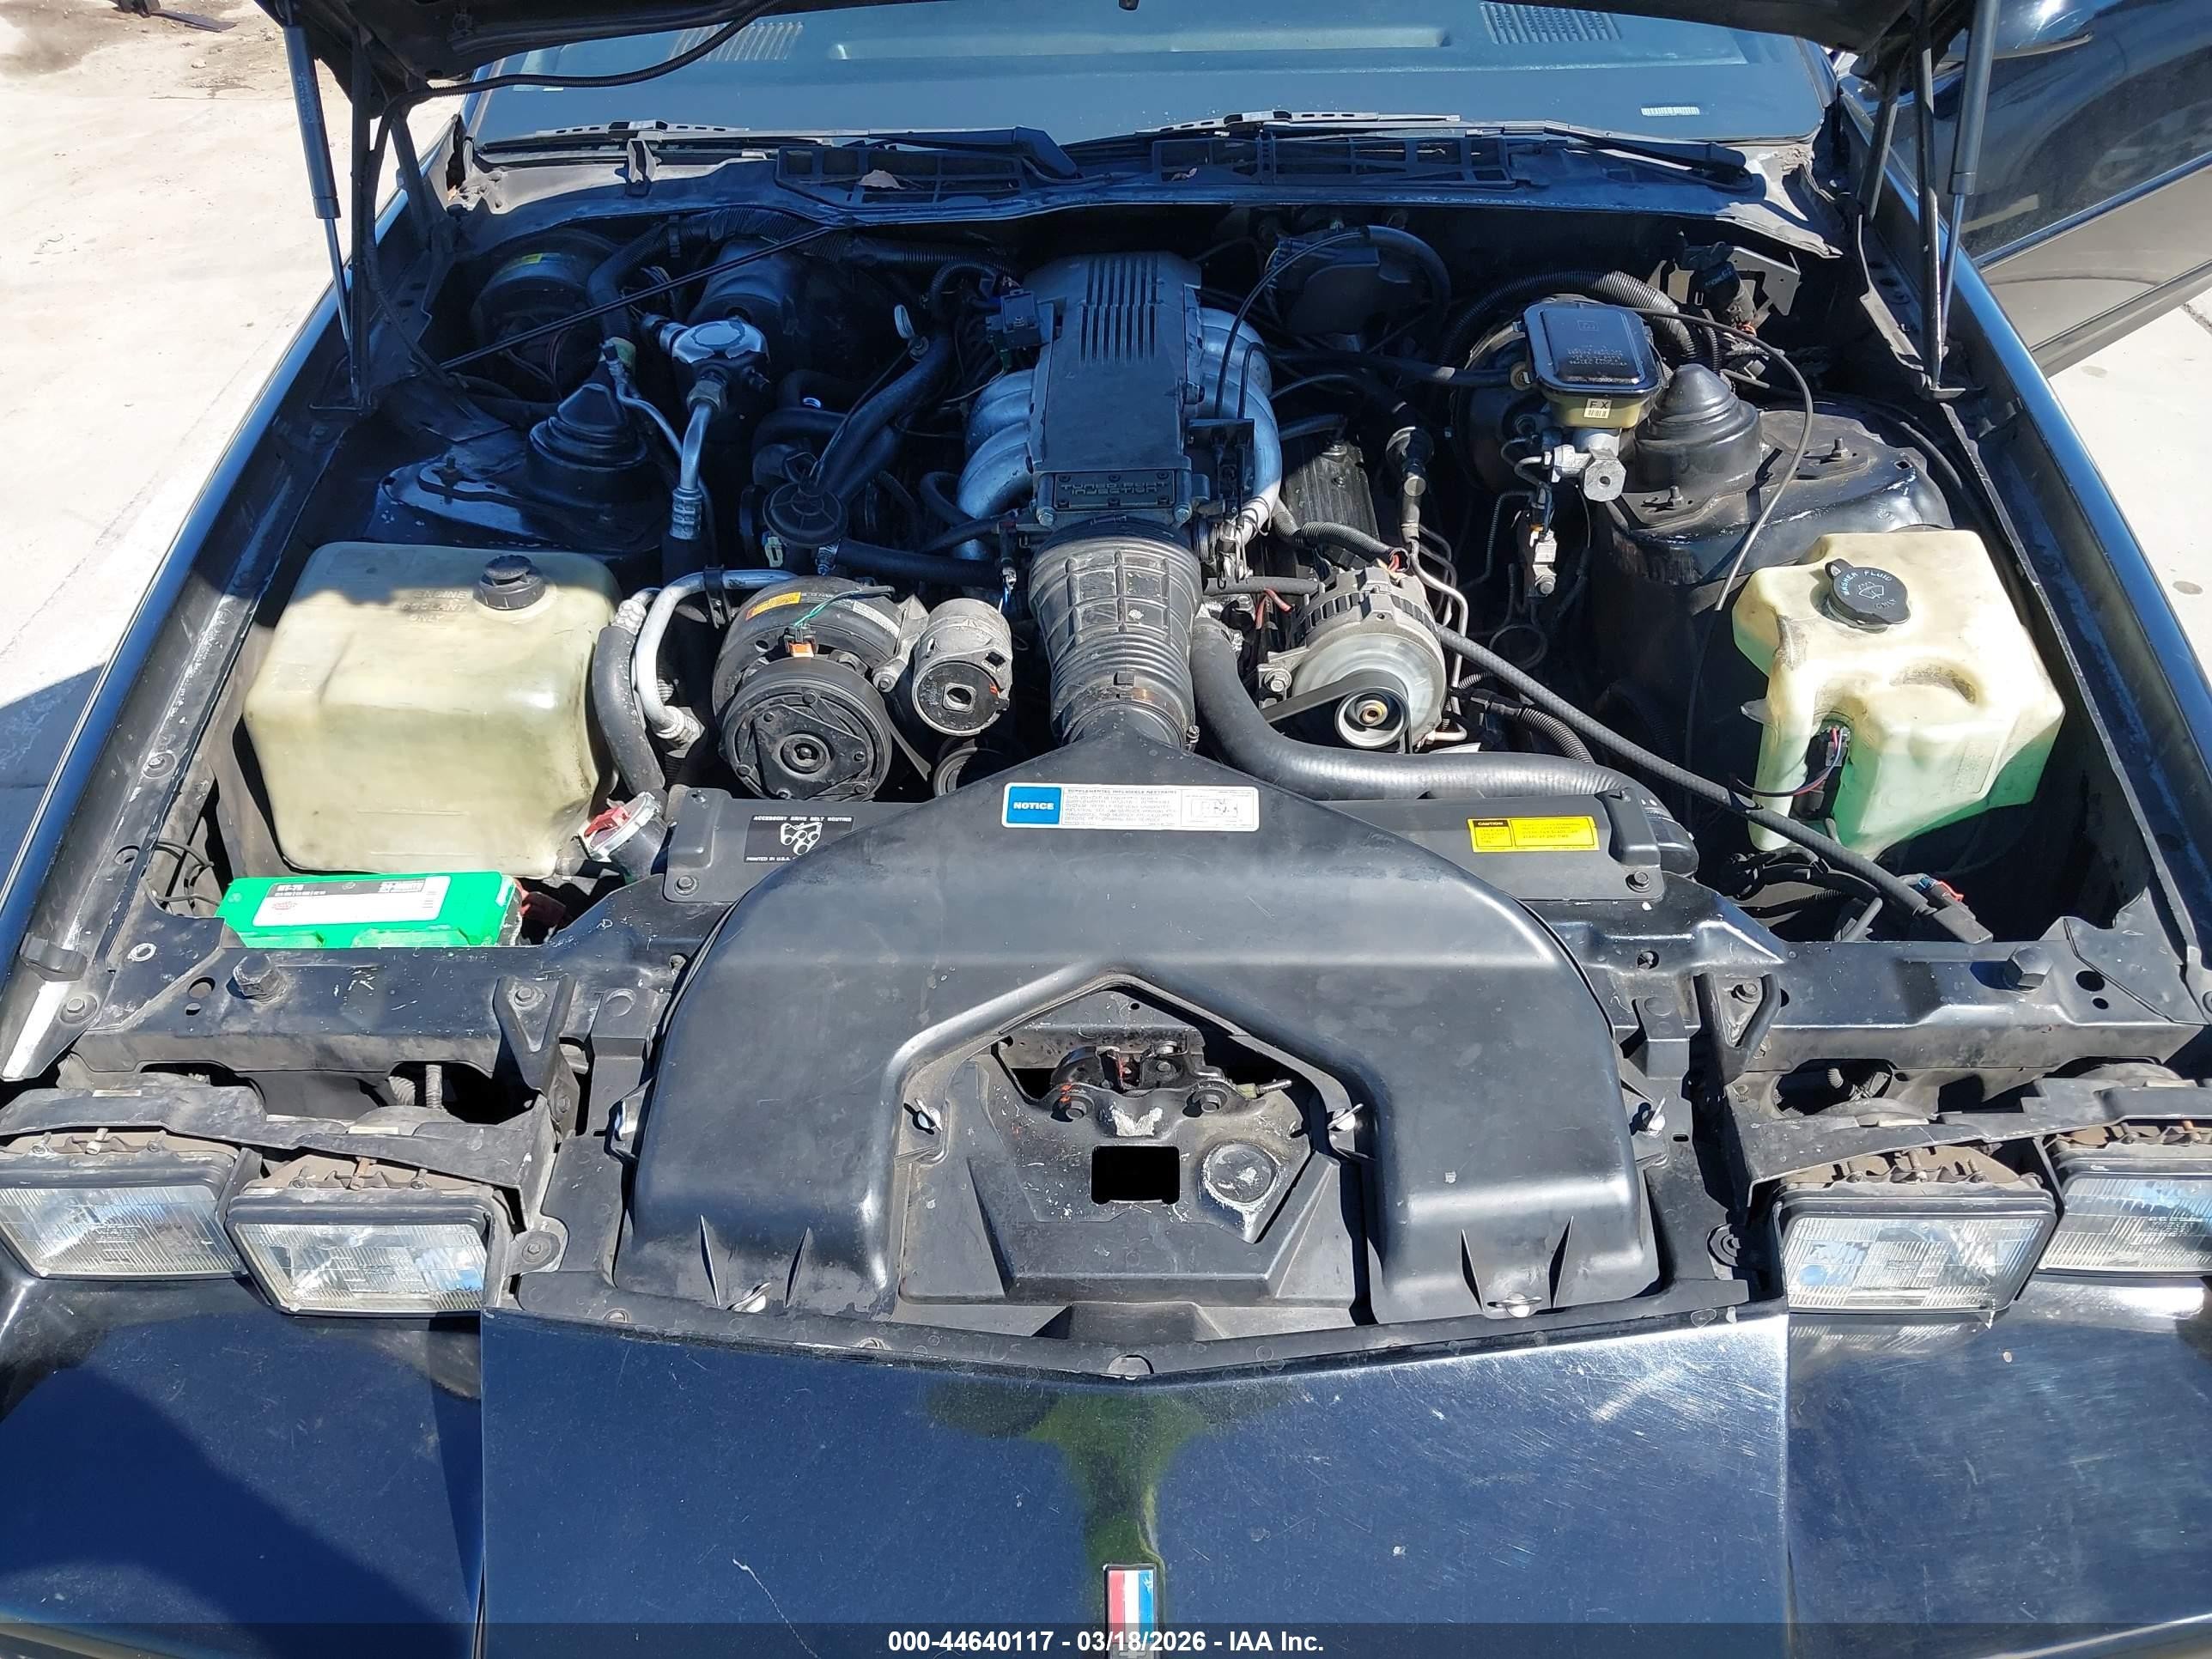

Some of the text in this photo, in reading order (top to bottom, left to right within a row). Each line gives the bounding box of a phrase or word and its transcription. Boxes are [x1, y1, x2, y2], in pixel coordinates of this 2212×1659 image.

[1071, 486, 1158, 495] INJECTION
[1839, 569, 1893, 596] WASHER FLUID
[413, 590, 468, 599] ENGINE
[401, 602, 468, 611] COOLANT
[1874, 598, 1897, 610] ONLY
[409, 614, 446, 623] ONLY
[1013, 801, 1054, 810] NOTICE
